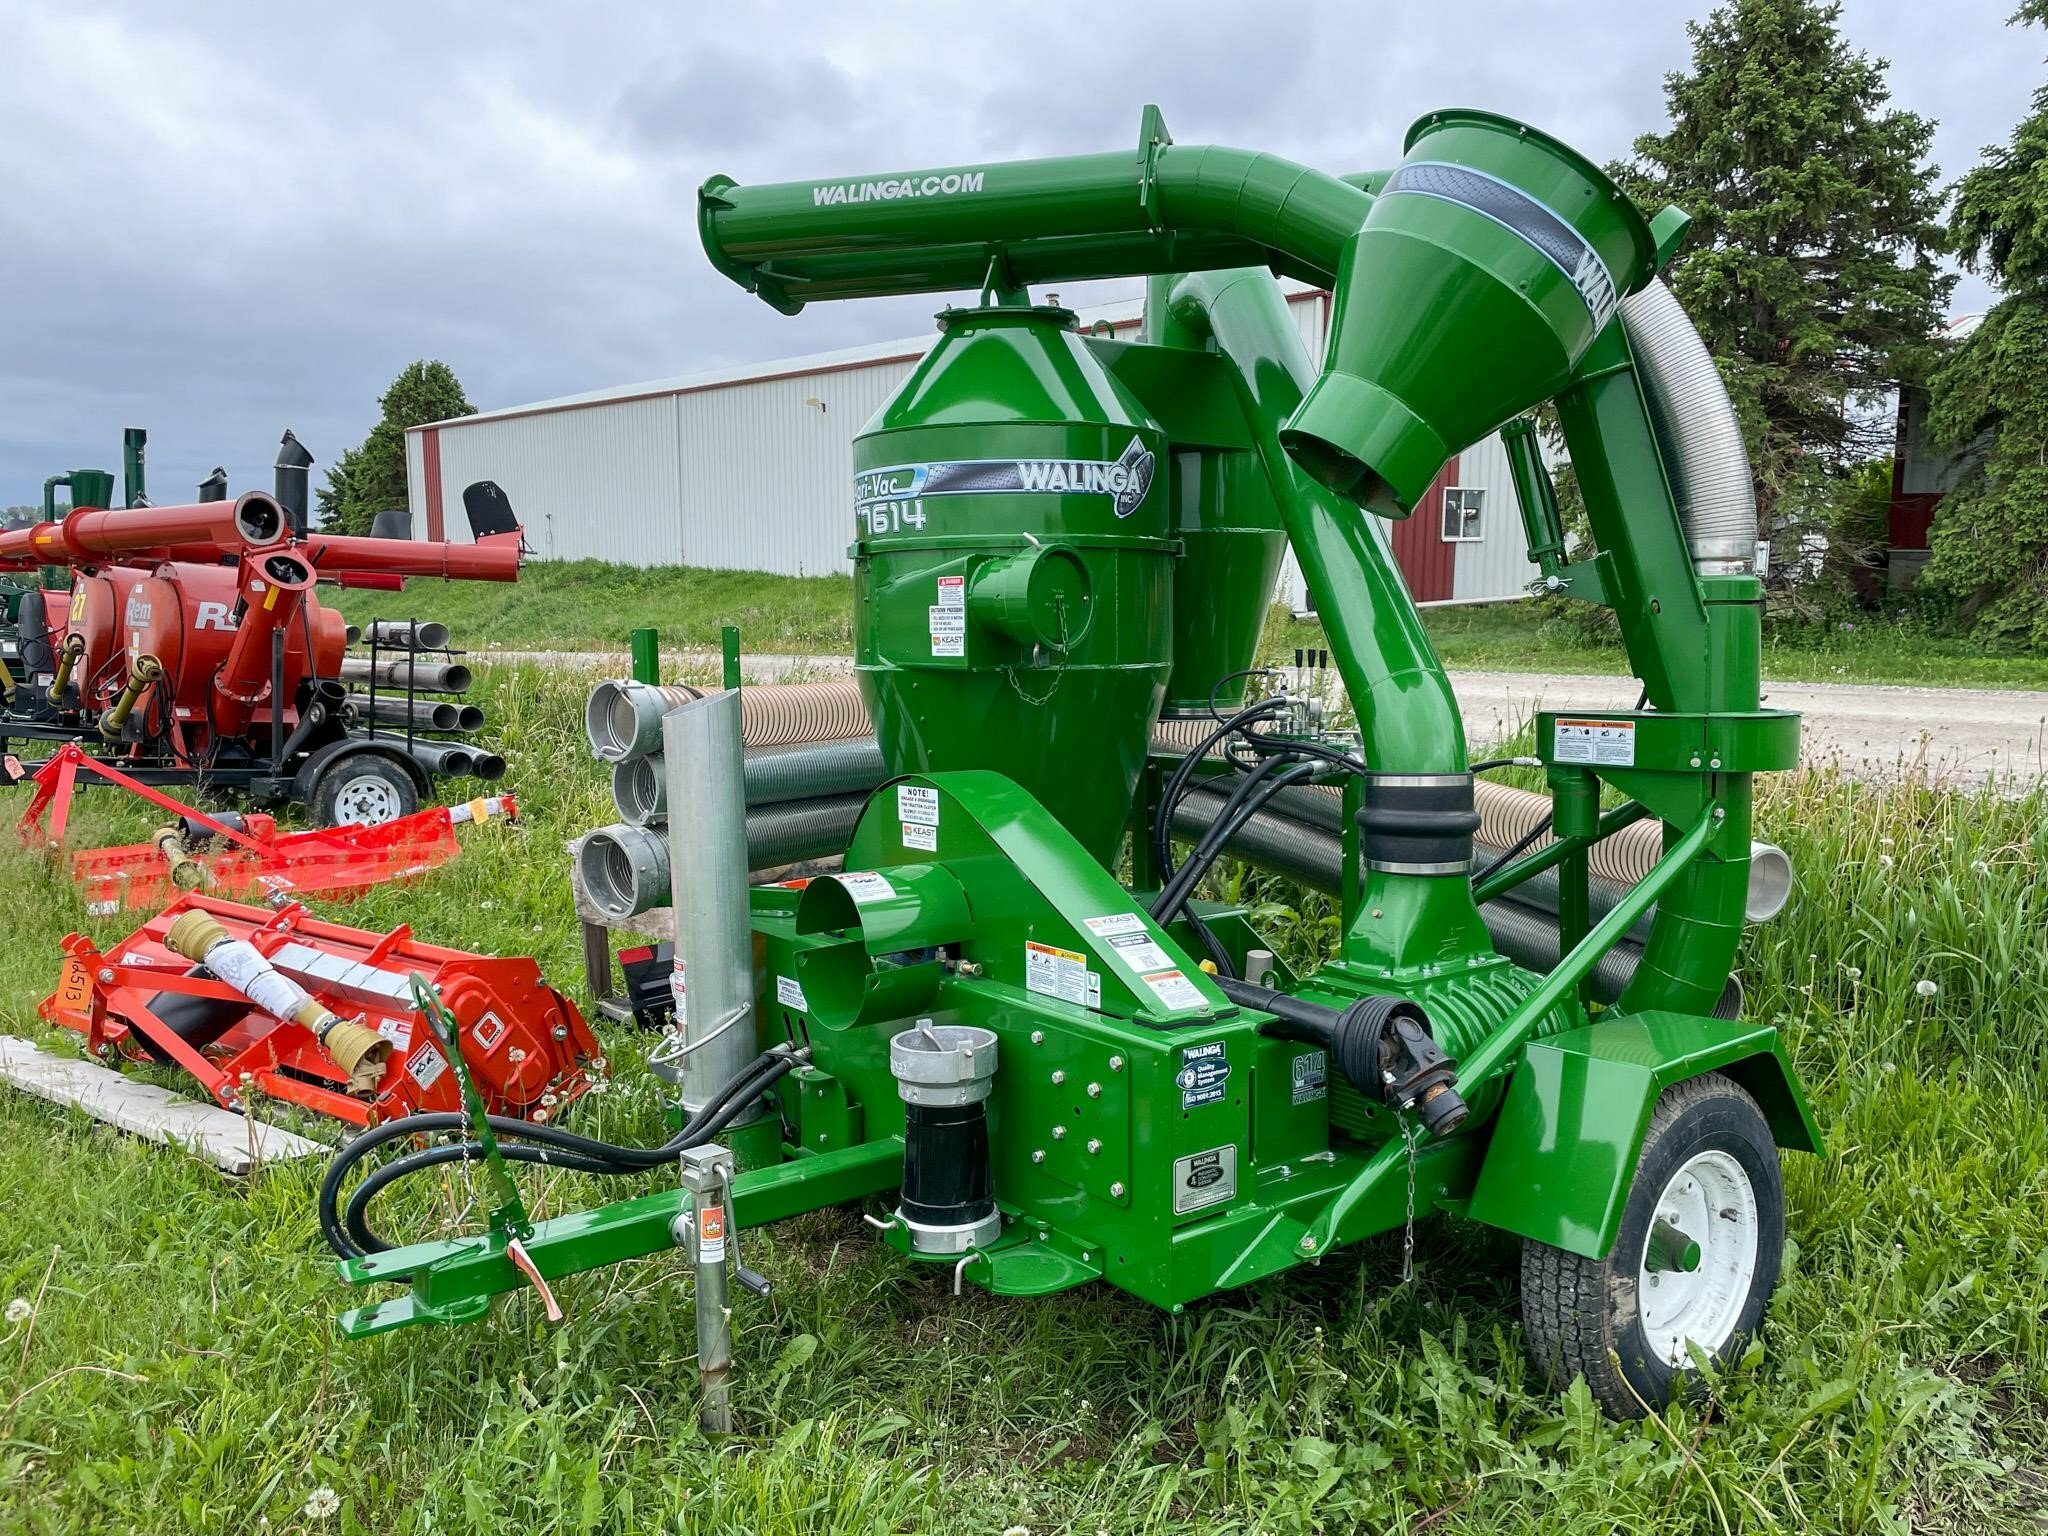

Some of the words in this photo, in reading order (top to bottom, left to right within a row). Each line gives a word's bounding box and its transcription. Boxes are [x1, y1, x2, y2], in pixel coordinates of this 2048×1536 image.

[1018, 462, 1142, 495] WALINGA
[859, 499, 927, 535] 7614
[126, 598, 152, 626] Rem
[941, 636, 963, 644] KEAST
[907, 788, 929, 798] NOTE!
[913, 826, 936, 838] KEAST
[1187, 1043, 1222, 1060] WALINGA
[1197, 1063, 1215, 1073] Quality
[1293, 1051, 1325, 1081] 614
[1197, 1067, 1228, 1079] Management
[1197, 1077, 1215, 1086] System
[1185, 1094, 1197, 1103] ISO
